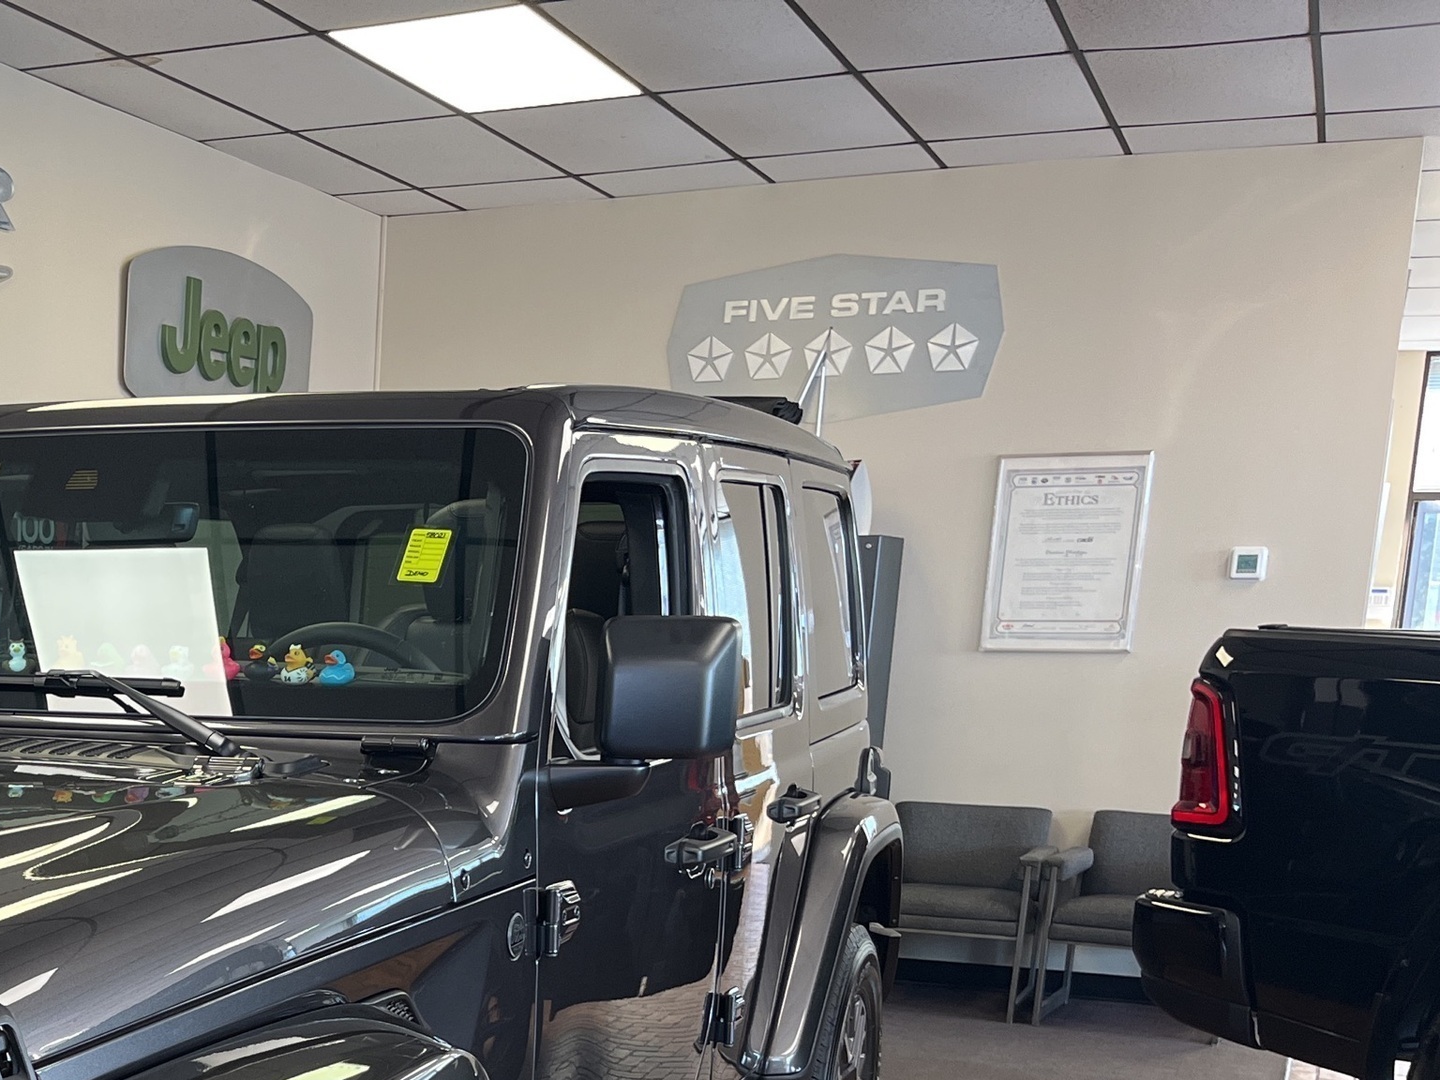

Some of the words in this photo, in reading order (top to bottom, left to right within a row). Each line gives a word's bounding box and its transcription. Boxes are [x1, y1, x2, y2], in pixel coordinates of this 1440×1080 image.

[724, 296, 816, 324] FIVE
[831, 288, 946, 318] STAR
[161, 276, 286, 393] Jeep
[13, 511, 55, 545] 100
